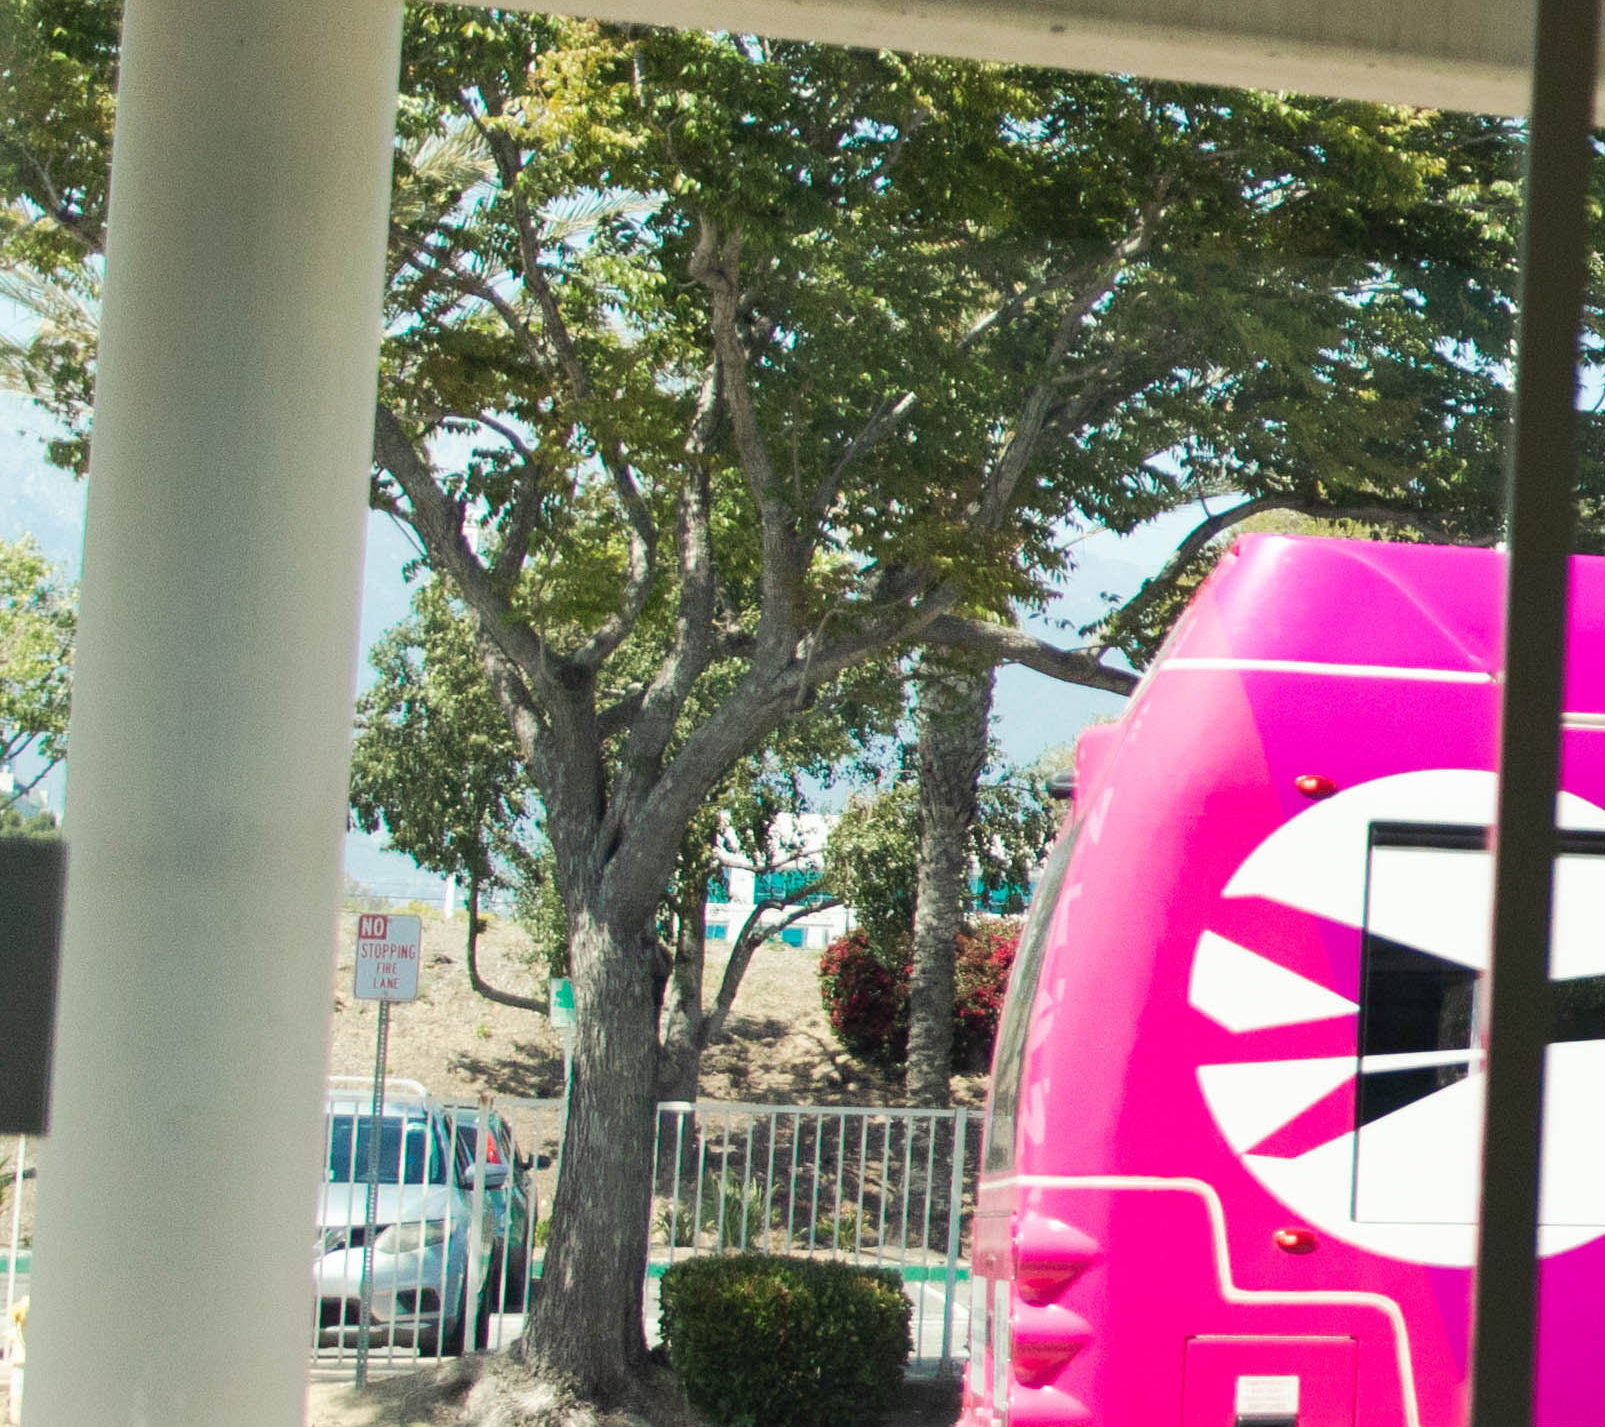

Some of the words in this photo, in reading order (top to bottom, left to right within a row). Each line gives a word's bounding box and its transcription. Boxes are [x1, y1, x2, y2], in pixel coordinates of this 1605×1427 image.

[362, 917, 385, 936] NO
[361, 943, 416, 959] STOPPING
[376, 962, 398, 975] FIRE
[373, 977, 400, 990] LANE
